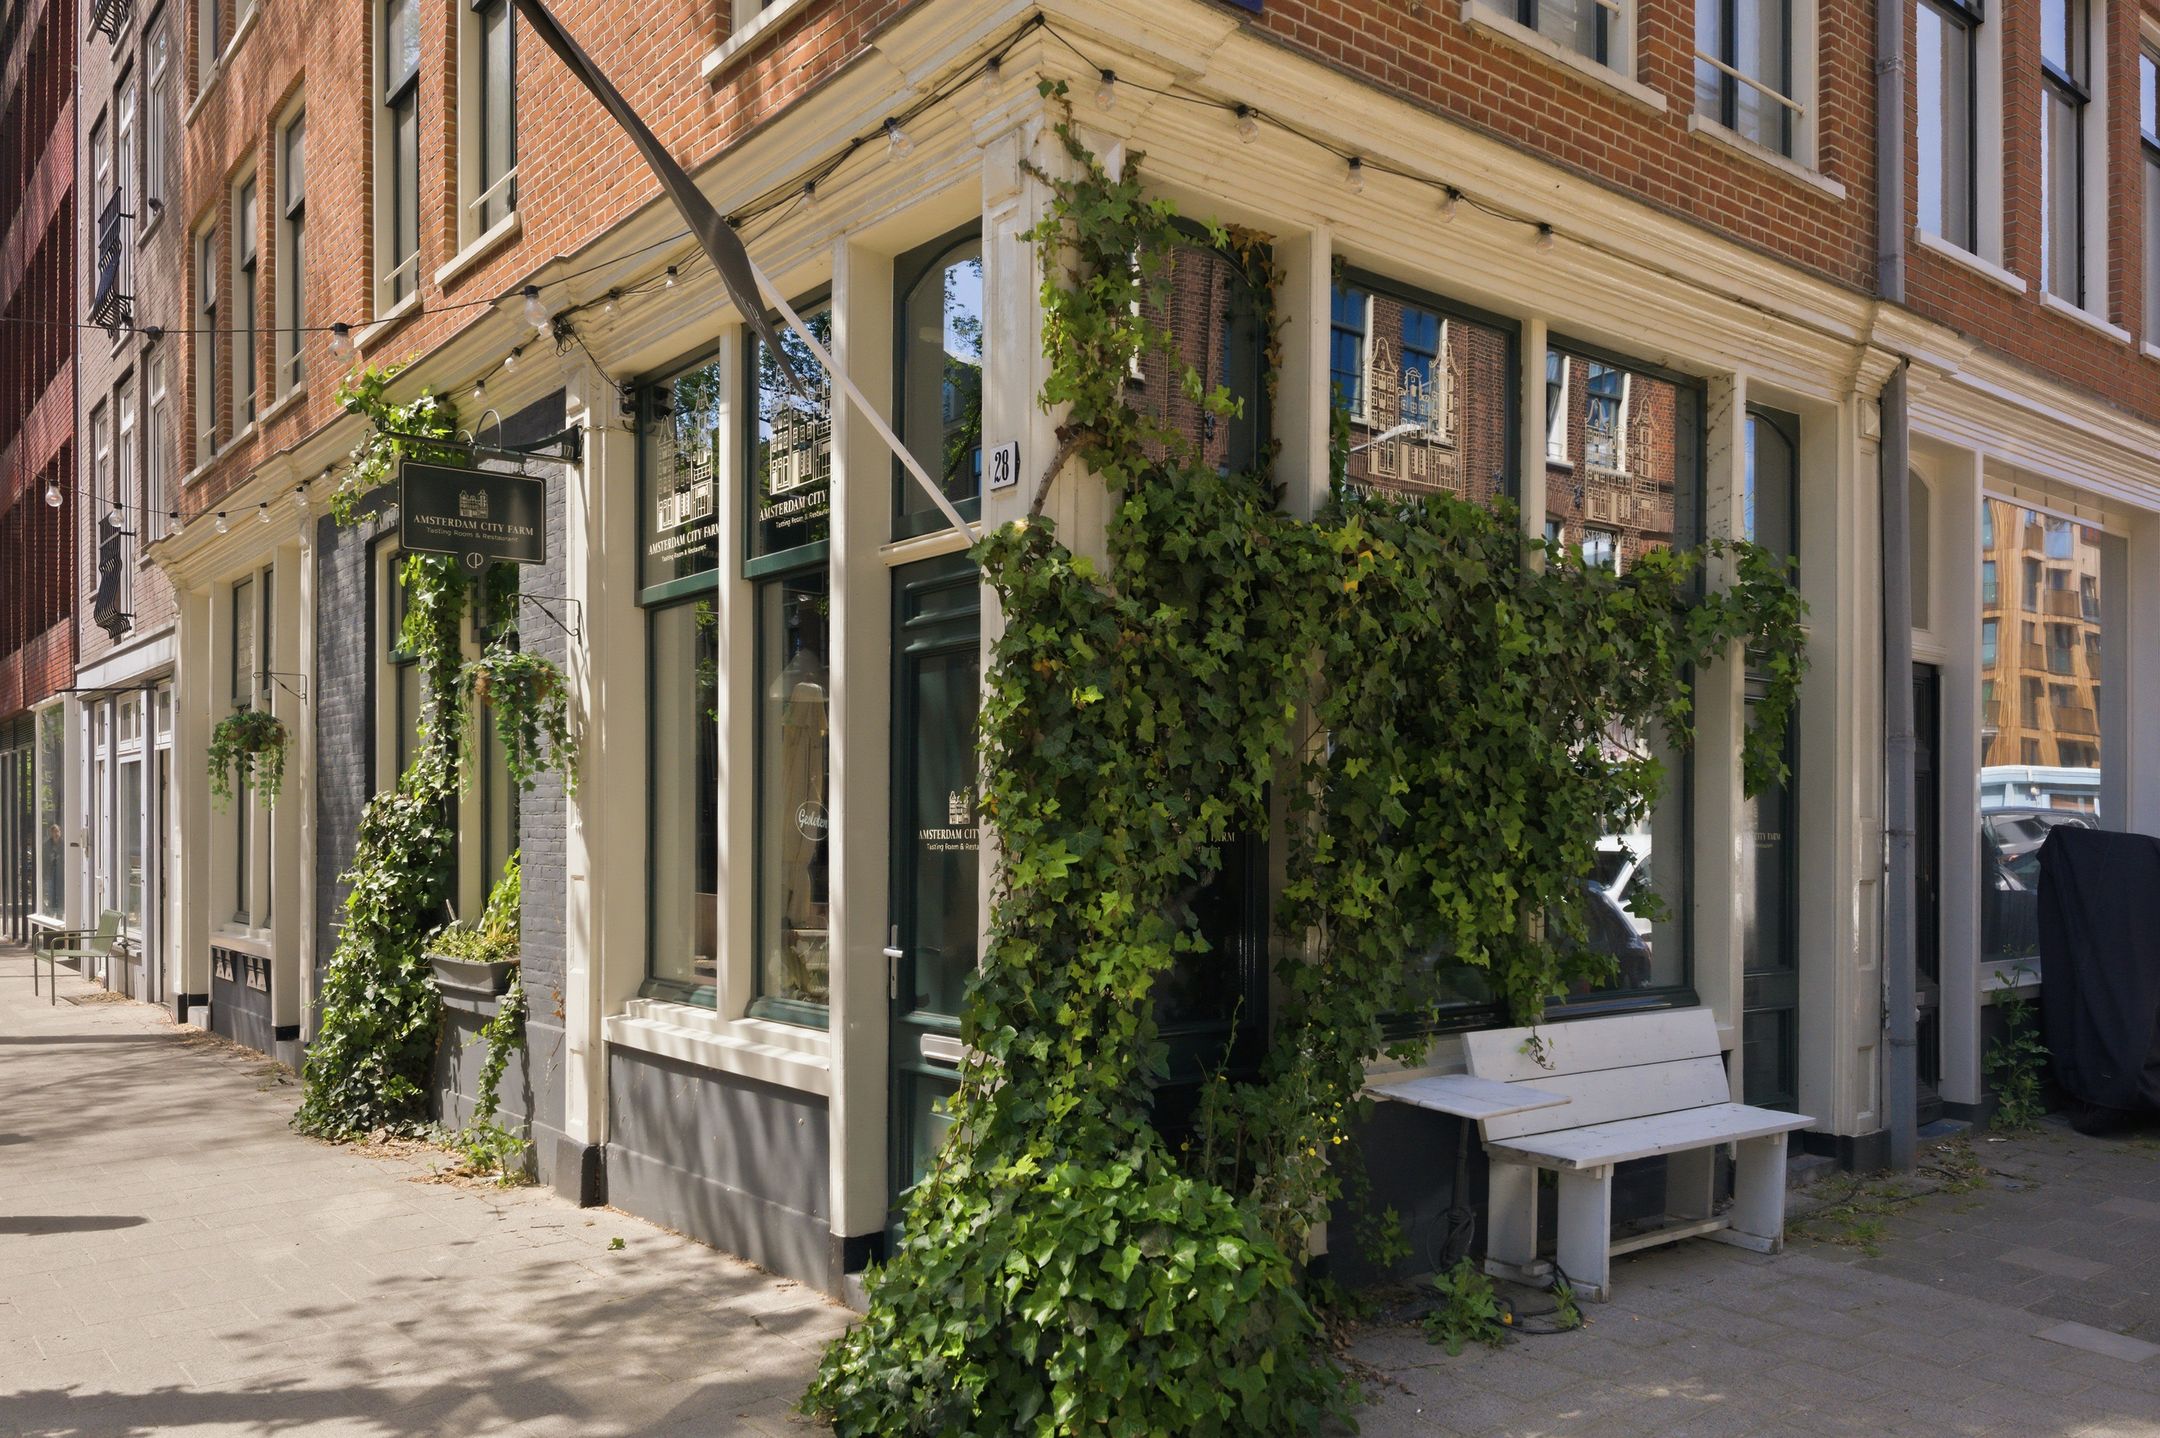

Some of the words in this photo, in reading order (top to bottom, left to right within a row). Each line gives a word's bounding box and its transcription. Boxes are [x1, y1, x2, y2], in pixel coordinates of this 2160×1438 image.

[994, 449, 1009, 483] 28
[759, 496, 806, 522] AMSTERDAM
[807, 489, 827, 506] CITY
[414, 514, 477, 529] AMSTERDAM
[480, 521, 504, 533] CITY
[507, 524, 534, 536] FARM
[427, 526, 452, 536] Tasting
[453, 529, 473, 538] Room
[482, 533, 519, 542] Restaurant
[648, 533, 685, 555] AMSTERDAM
[686, 527, 702, 543] CITY
[919, 828, 962, 839] AMSTERDAM
